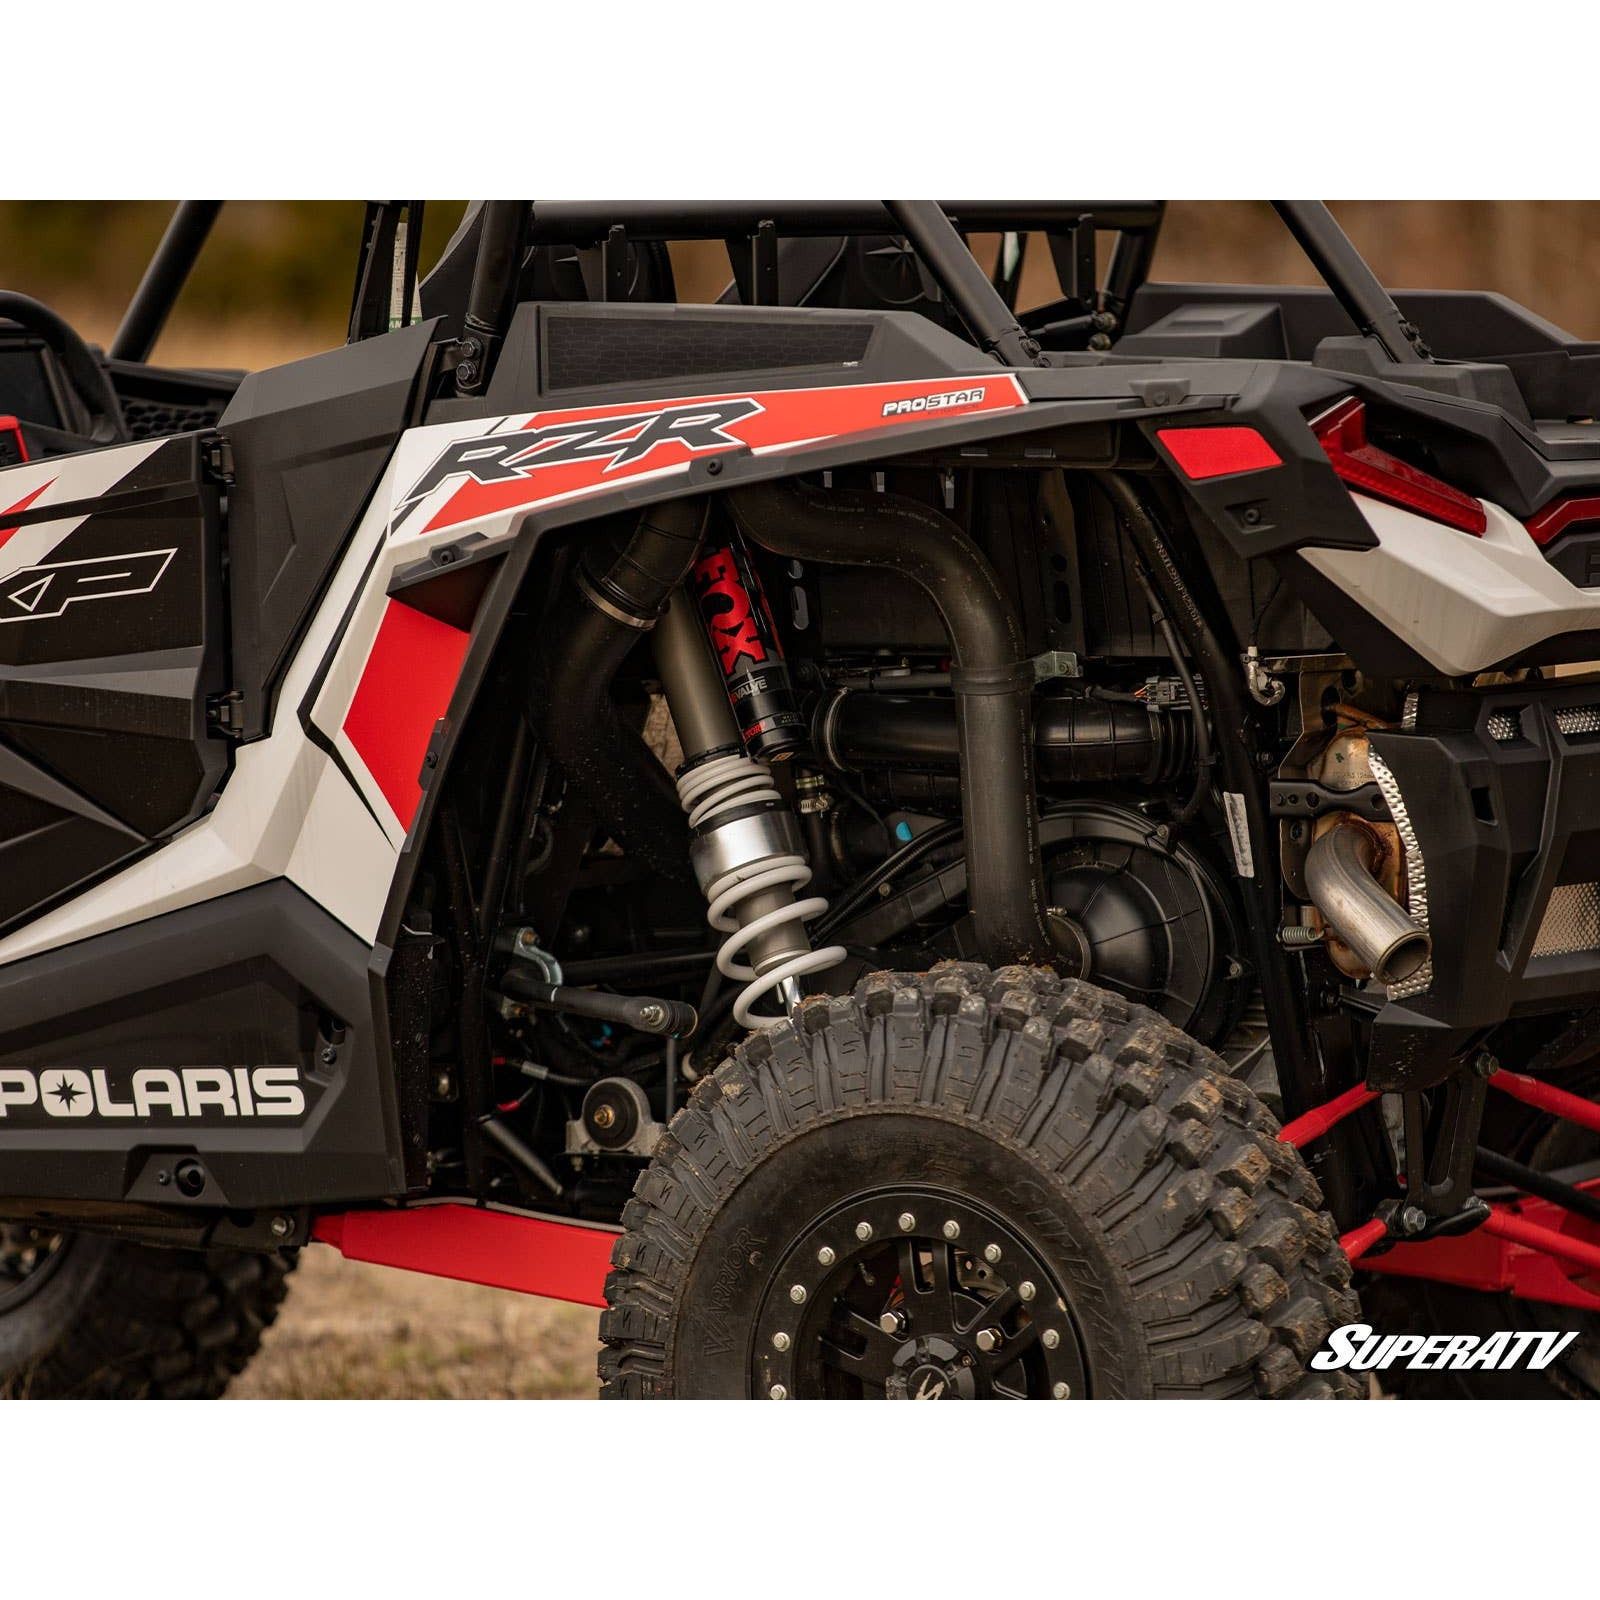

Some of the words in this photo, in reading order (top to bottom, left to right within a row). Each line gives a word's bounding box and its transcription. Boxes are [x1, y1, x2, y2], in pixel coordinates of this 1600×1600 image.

[394, 397, 766, 511] RZR
[882, 387, 986, 417] PROSTAR
[694, 547, 768, 676] FOX
[0, 1067, 306, 1117] POLARIS
[699, 1225, 768, 1357] WARRIOR
